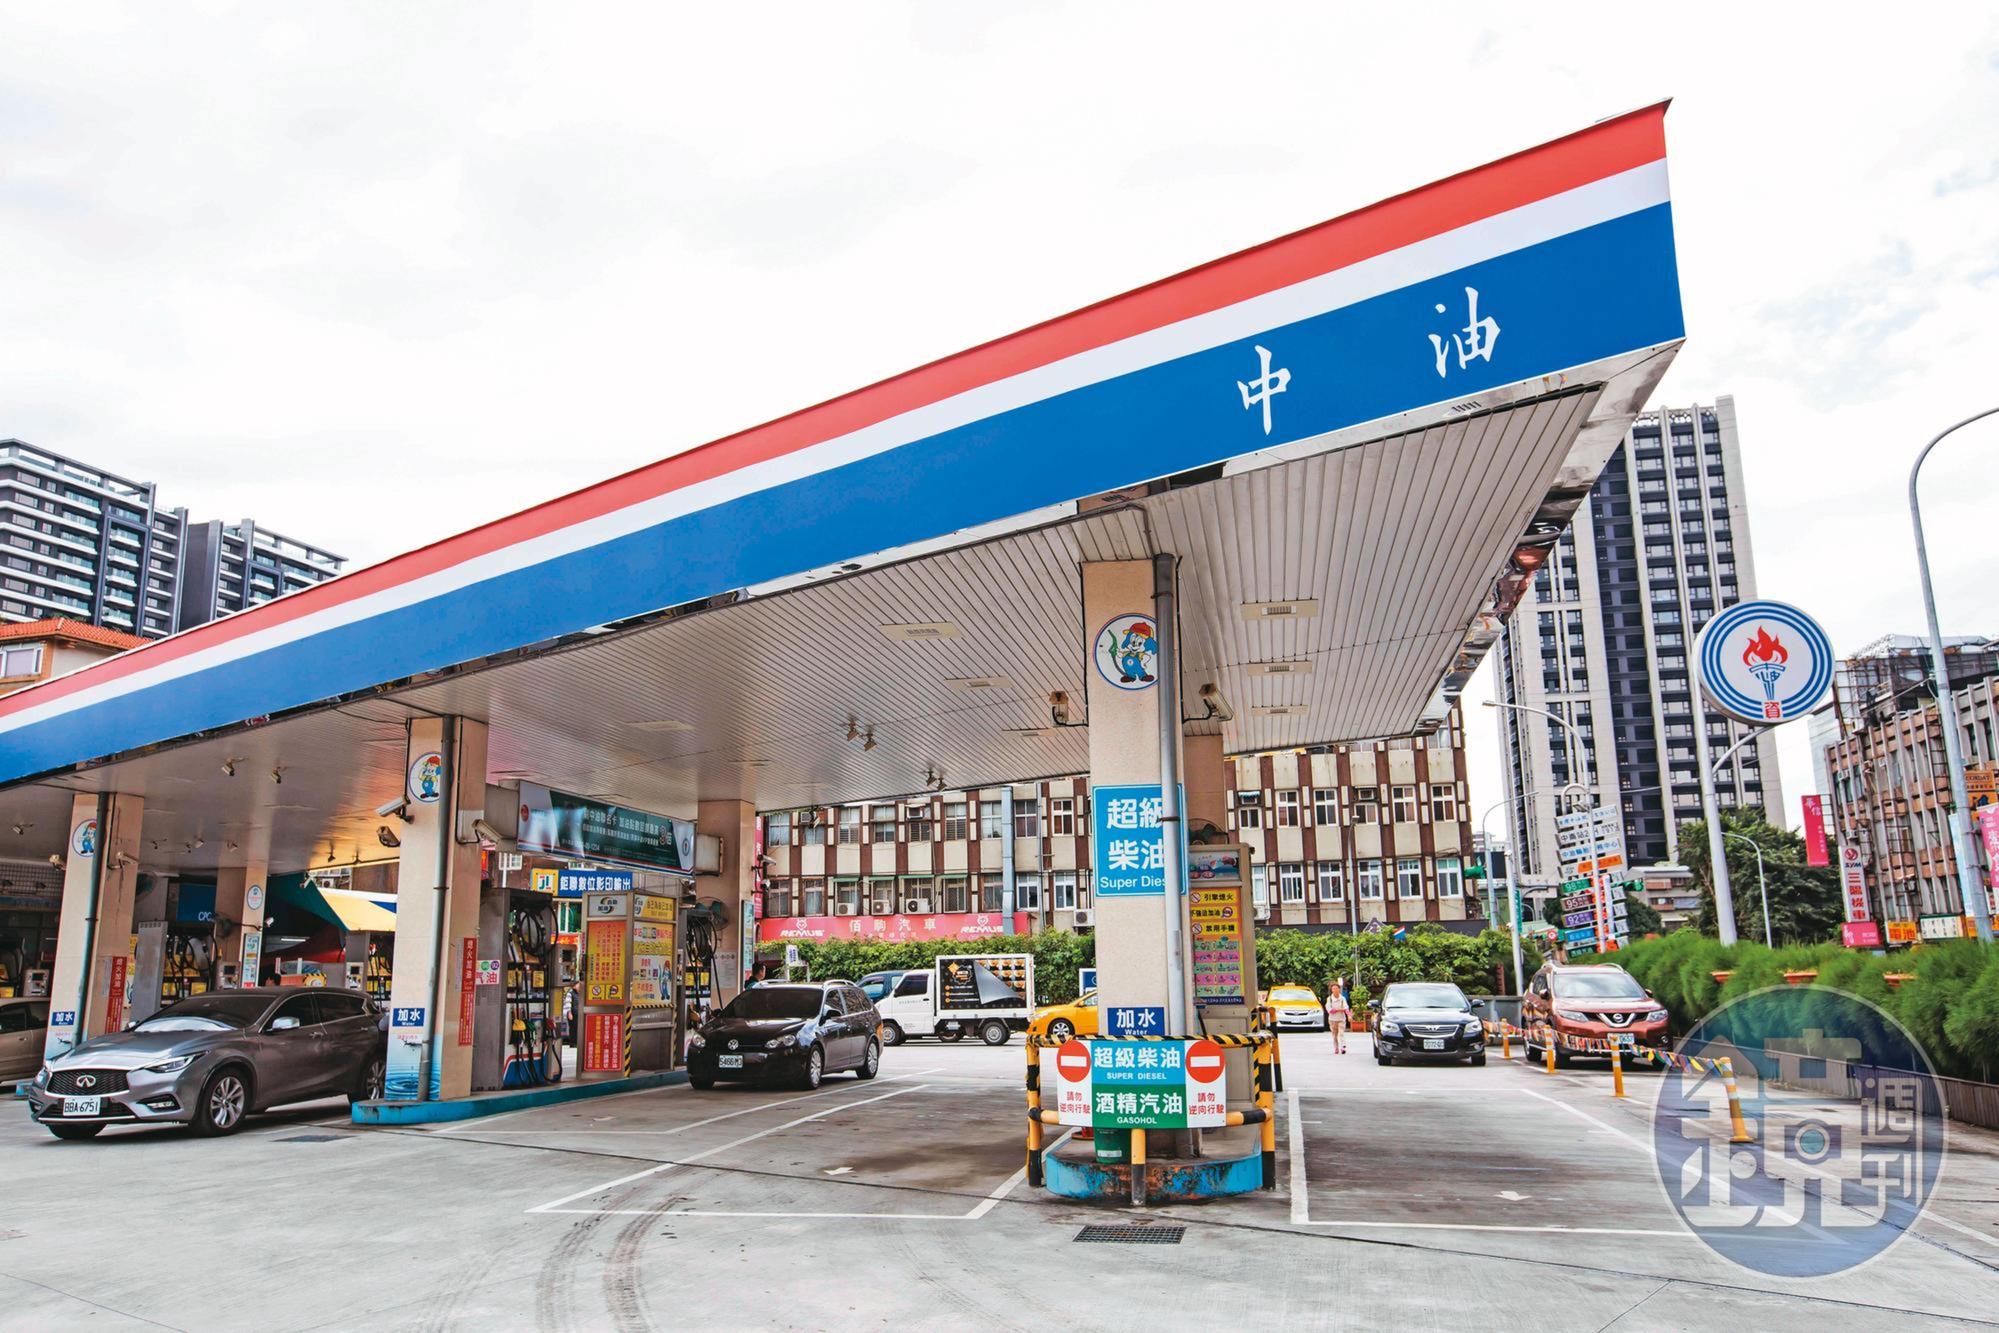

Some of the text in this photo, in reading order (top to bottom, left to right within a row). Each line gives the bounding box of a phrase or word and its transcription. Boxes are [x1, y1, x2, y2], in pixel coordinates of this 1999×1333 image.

[1237, 286, 1500, 435] 中油
[1106, 798, 1163, 829] 超級
[1108, 839, 1164, 870] 柴油
[1100, 876, 1138, 890] Super
[1566, 898, 1578, 908] 95
[1567, 914, 1579, 925] 92
[780, 929, 823, 937] REMUS
[55, 1012, 73, 1022] 加水
[398, 1009, 420, 1021] 加水
[1116, 1009, 1156, 1028] 加水
[1094, 1047, 1181, 1069] 超級柴油
[1107, 1072, 1167, 1080] SUPER DIESEL
[1066, 1091, 1082, 1100] 請勿
[1197, 1092, 1216, 1102] 請勿
[1059, 1103, 1091, 1114] 逆向行駛
[1095, 1092, 1182, 1115] 酒精汽油
[1189, 1103, 1225, 1115] 逆向行駛
